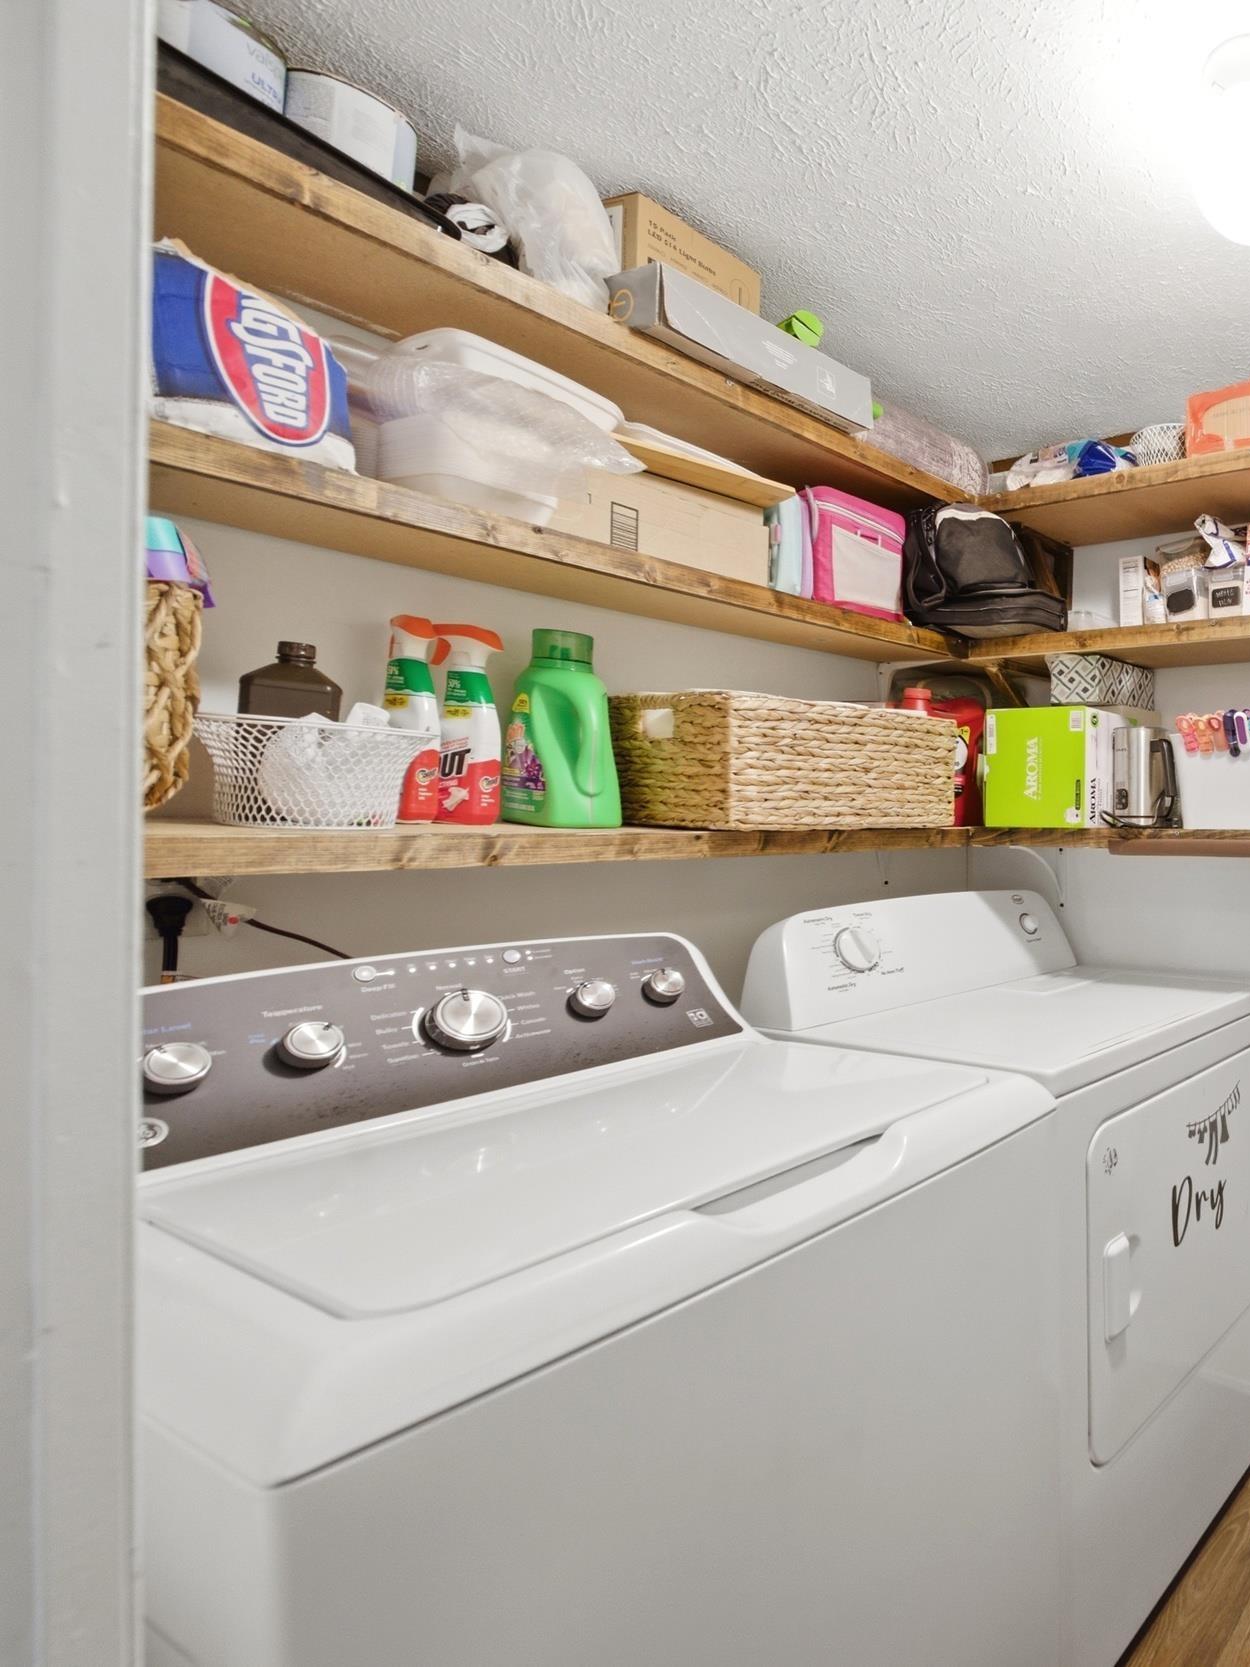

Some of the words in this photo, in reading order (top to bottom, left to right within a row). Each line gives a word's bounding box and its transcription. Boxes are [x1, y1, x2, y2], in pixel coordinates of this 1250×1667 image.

[1024, 736, 1039, 800] AROMA
[1089, 777, 1098, 825] AROMA
[261, 1004, 323, 1019] Temperature
[1172, 1176, 1227, 1248] Dry
